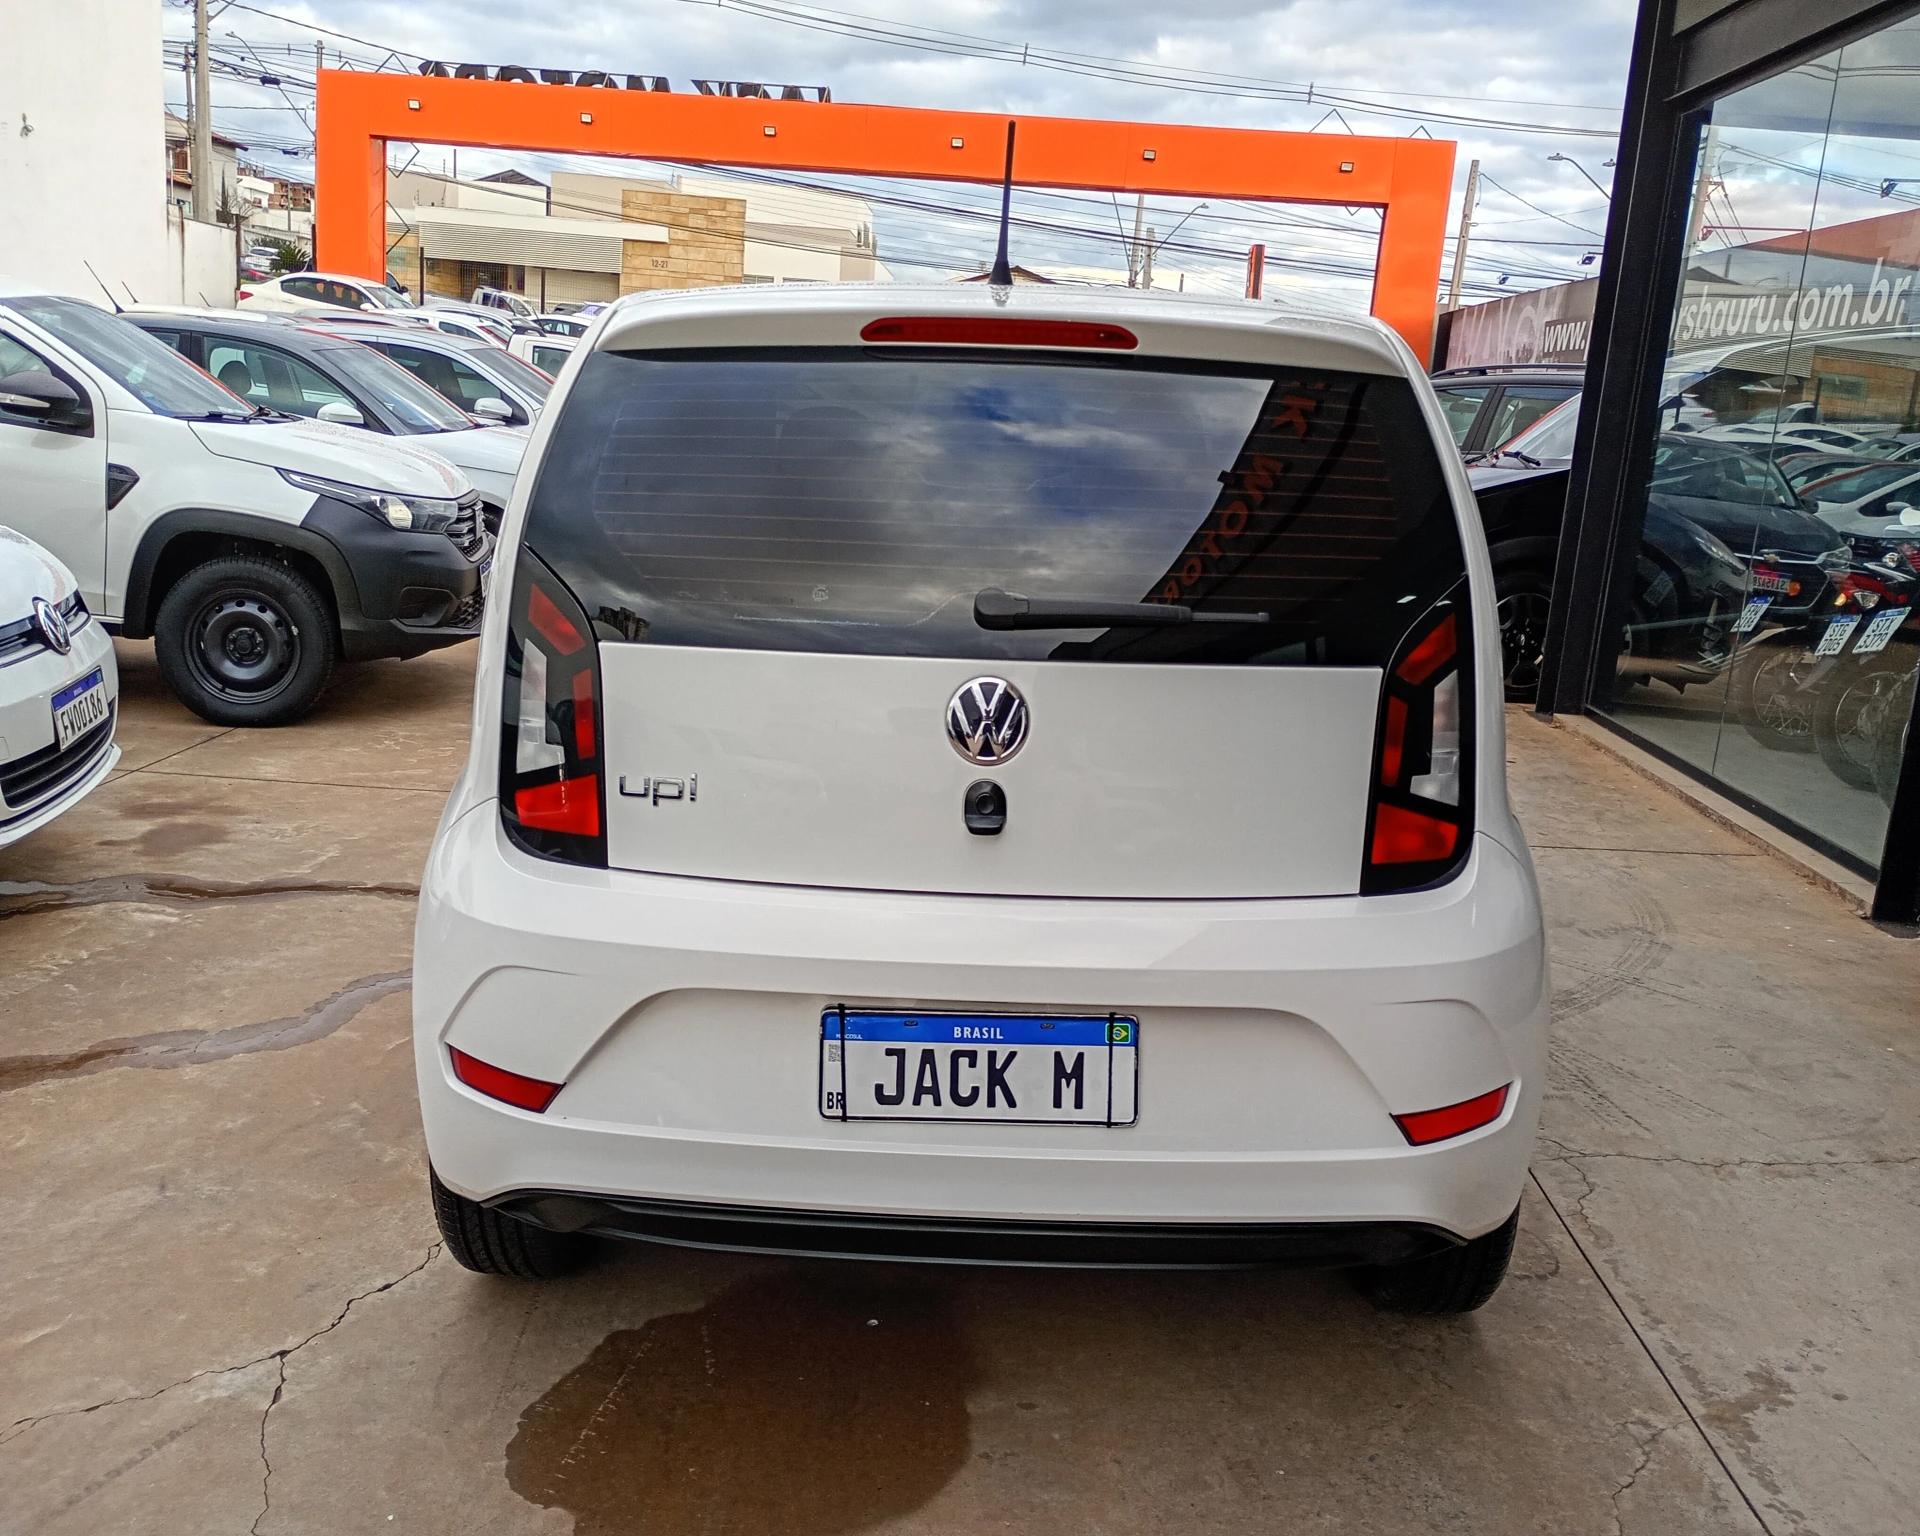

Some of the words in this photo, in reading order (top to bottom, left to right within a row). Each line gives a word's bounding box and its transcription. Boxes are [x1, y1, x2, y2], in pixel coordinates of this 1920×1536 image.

[651, 258, 668, 268] 12-21
[1544, 321, 1586, 353] www.
[953, 1026, 1004, 1040] BRASIL
[874, 1047, 1017, 1108] JACK
[1052, 1050, 1084, 1110] M
[826, 1091, 846, 1110] BR
